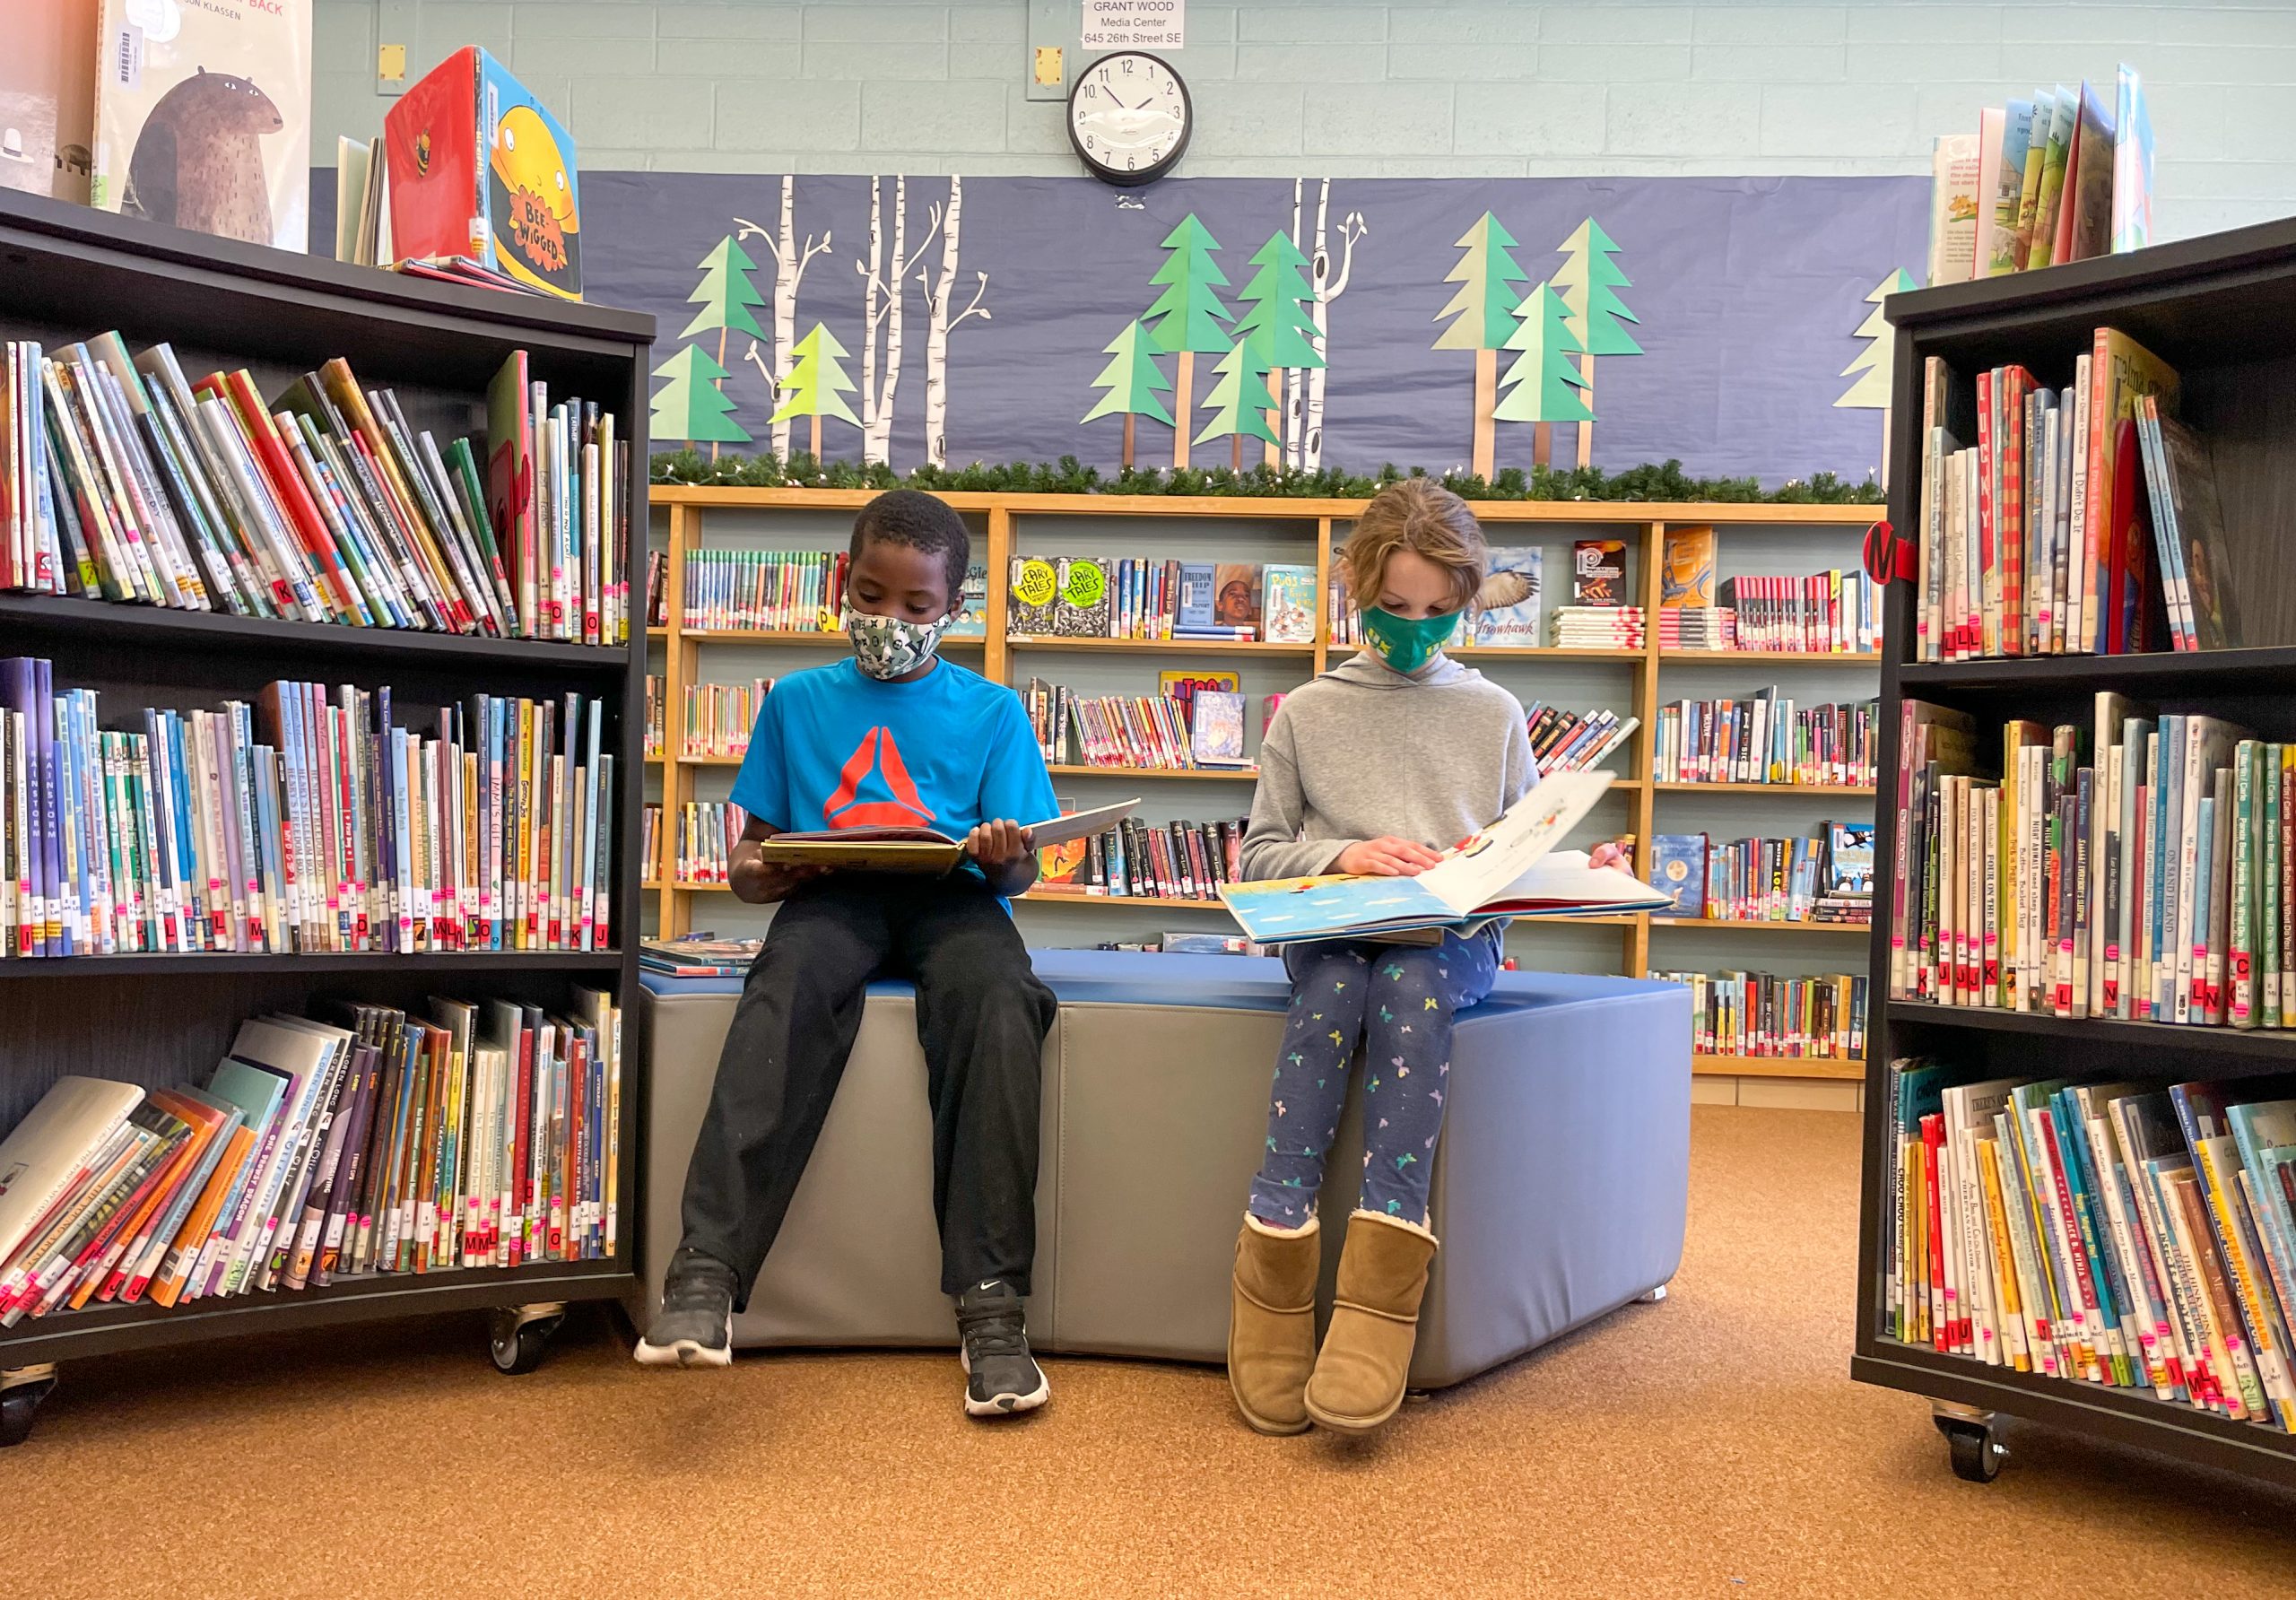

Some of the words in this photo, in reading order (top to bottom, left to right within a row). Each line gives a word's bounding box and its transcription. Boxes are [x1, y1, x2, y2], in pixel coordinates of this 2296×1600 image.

[203, 4, 241, 21] KLASSEN
[248, 0, 283, 16] BACK
[1093, 1, 1134, 12] GRANT
[1138, 1, 1174, 12] WOOD
[1100, 18, 1130, 27] Media
[1134, 18, 1167, 27] Center
[1084, 33, 1103, 43] 645
[1107, 33, 1129, 43] 26th
[1132, 33, 1163, 43] Street
[1166, 33, 1181, 43] SE
[1099, 68, 1109, 82] 11
[1121, 60, 1133, 74] 12
[1149, 66, 1153, 79] 1
[1083, 85, 1095, 99] 10
[1167, 82, 1173, 95] 2
[1079, 111, 1086, 125] 9
[1173, 106, 1180, 118] 3
[1087, 135, 1093, 149] 8
[1104, 152, 1111, 165] 7
[1127, 157, 1135, 170] 6
[1152, 149, 1159, 162] 5
[525, 201, 550, 230] BEE-
[1978, 380, 1990, 529] LUCKY
[2074, 480, 2083, 507] Didn't
[2074, 509, 2083, 521] Do
[2073, 525, 2082, 534] It
[1868, 525, 1898, 580] M
[1022, 570, 1048, 586] CARY
[1068, 570, 1094, 587] CARY
[1185, 572, 1211, 581] FREEDOM
[279, 585, 291, 600] K
[1019, 578, 1052, 597] TALES
[1066, 578, 1099, 598] TALES
[552, 605, 561, 619] O
[587, 615, 597, 629] O
[30, 750, 40, 838] RAINSTORM
[46, 752, 57, 839] RAINSTORM
[491, 778, 500, 819] IMMI'S
[491, 823, 500, 849] GIFT
[2031, 822, 2039, 840] NIGHT
[2239, 817, 2248, 840] Panda
[2283, 826, 2291, 844] Baby
[2167, 850, 2176, 863] ON
[1986, 855, 1995, 881] FOUR
[2239, 862, 2247, 885] Panda
[2266, 863, 2274, 884] Panda
[2283, 866, 2291, 884] Baby
[2166, 866, 2176, 891] SAND
[1986, 883, 1994, 895] ON
[1986, 898, 1994, 917] THE
[2076, 899, 2084, 922] SLEEPING
[2164, 895, 2175, 933] ISLAND
[2239, 907, 2247, 923] What
[2266, 907, 2274, 926] What
[252, 923, 262, 935] M
[358, 919, 367, 932] O
[481, 924, 491, 936] O
[2239, 926, 2246, 935] Do
[2266, 927, 2274, 937] Do
[2283, 925, 2291, 934] Do
[596, 929, 604, 942] J
[2266, 939, 2274, 952] You
[2237, 958, 2248, 975] C
[2266, 954, 2274, 972] See?
[1939, 965, 1946, 980] J
[1985, 964, 1996, 981] K
[2059, 989, 2067, 1005] L
[2206, 992, 2217, 1007] N
[314, 1056, 327, 1086] LOREN
[325, 1052, 340, 1086] LOREN
[340, 1054, 352, 1082] LOREN
[300, 1086, 315, 1113] LONG
[329, 1082, 342, 1106] LONG
[235, 1188, 254, 1222] DRAGON
[57, 1200, 87, 1236] YOUNG
[551, 1232, 561, 1246] O
[2114, 1221, 2129, 1247] Jeremy
[28, 1231, 58, 1266] ARTIST
[465, 1237, 476, 1250] M
[2066, 1220, 2077, 1241] JACK
[2073, 1254, 2084, 1276] NINJA
[2224, 1224, 2258, 1300] CATERPILLAR
[2249, 1303, 2272, 1350] DREAMS
